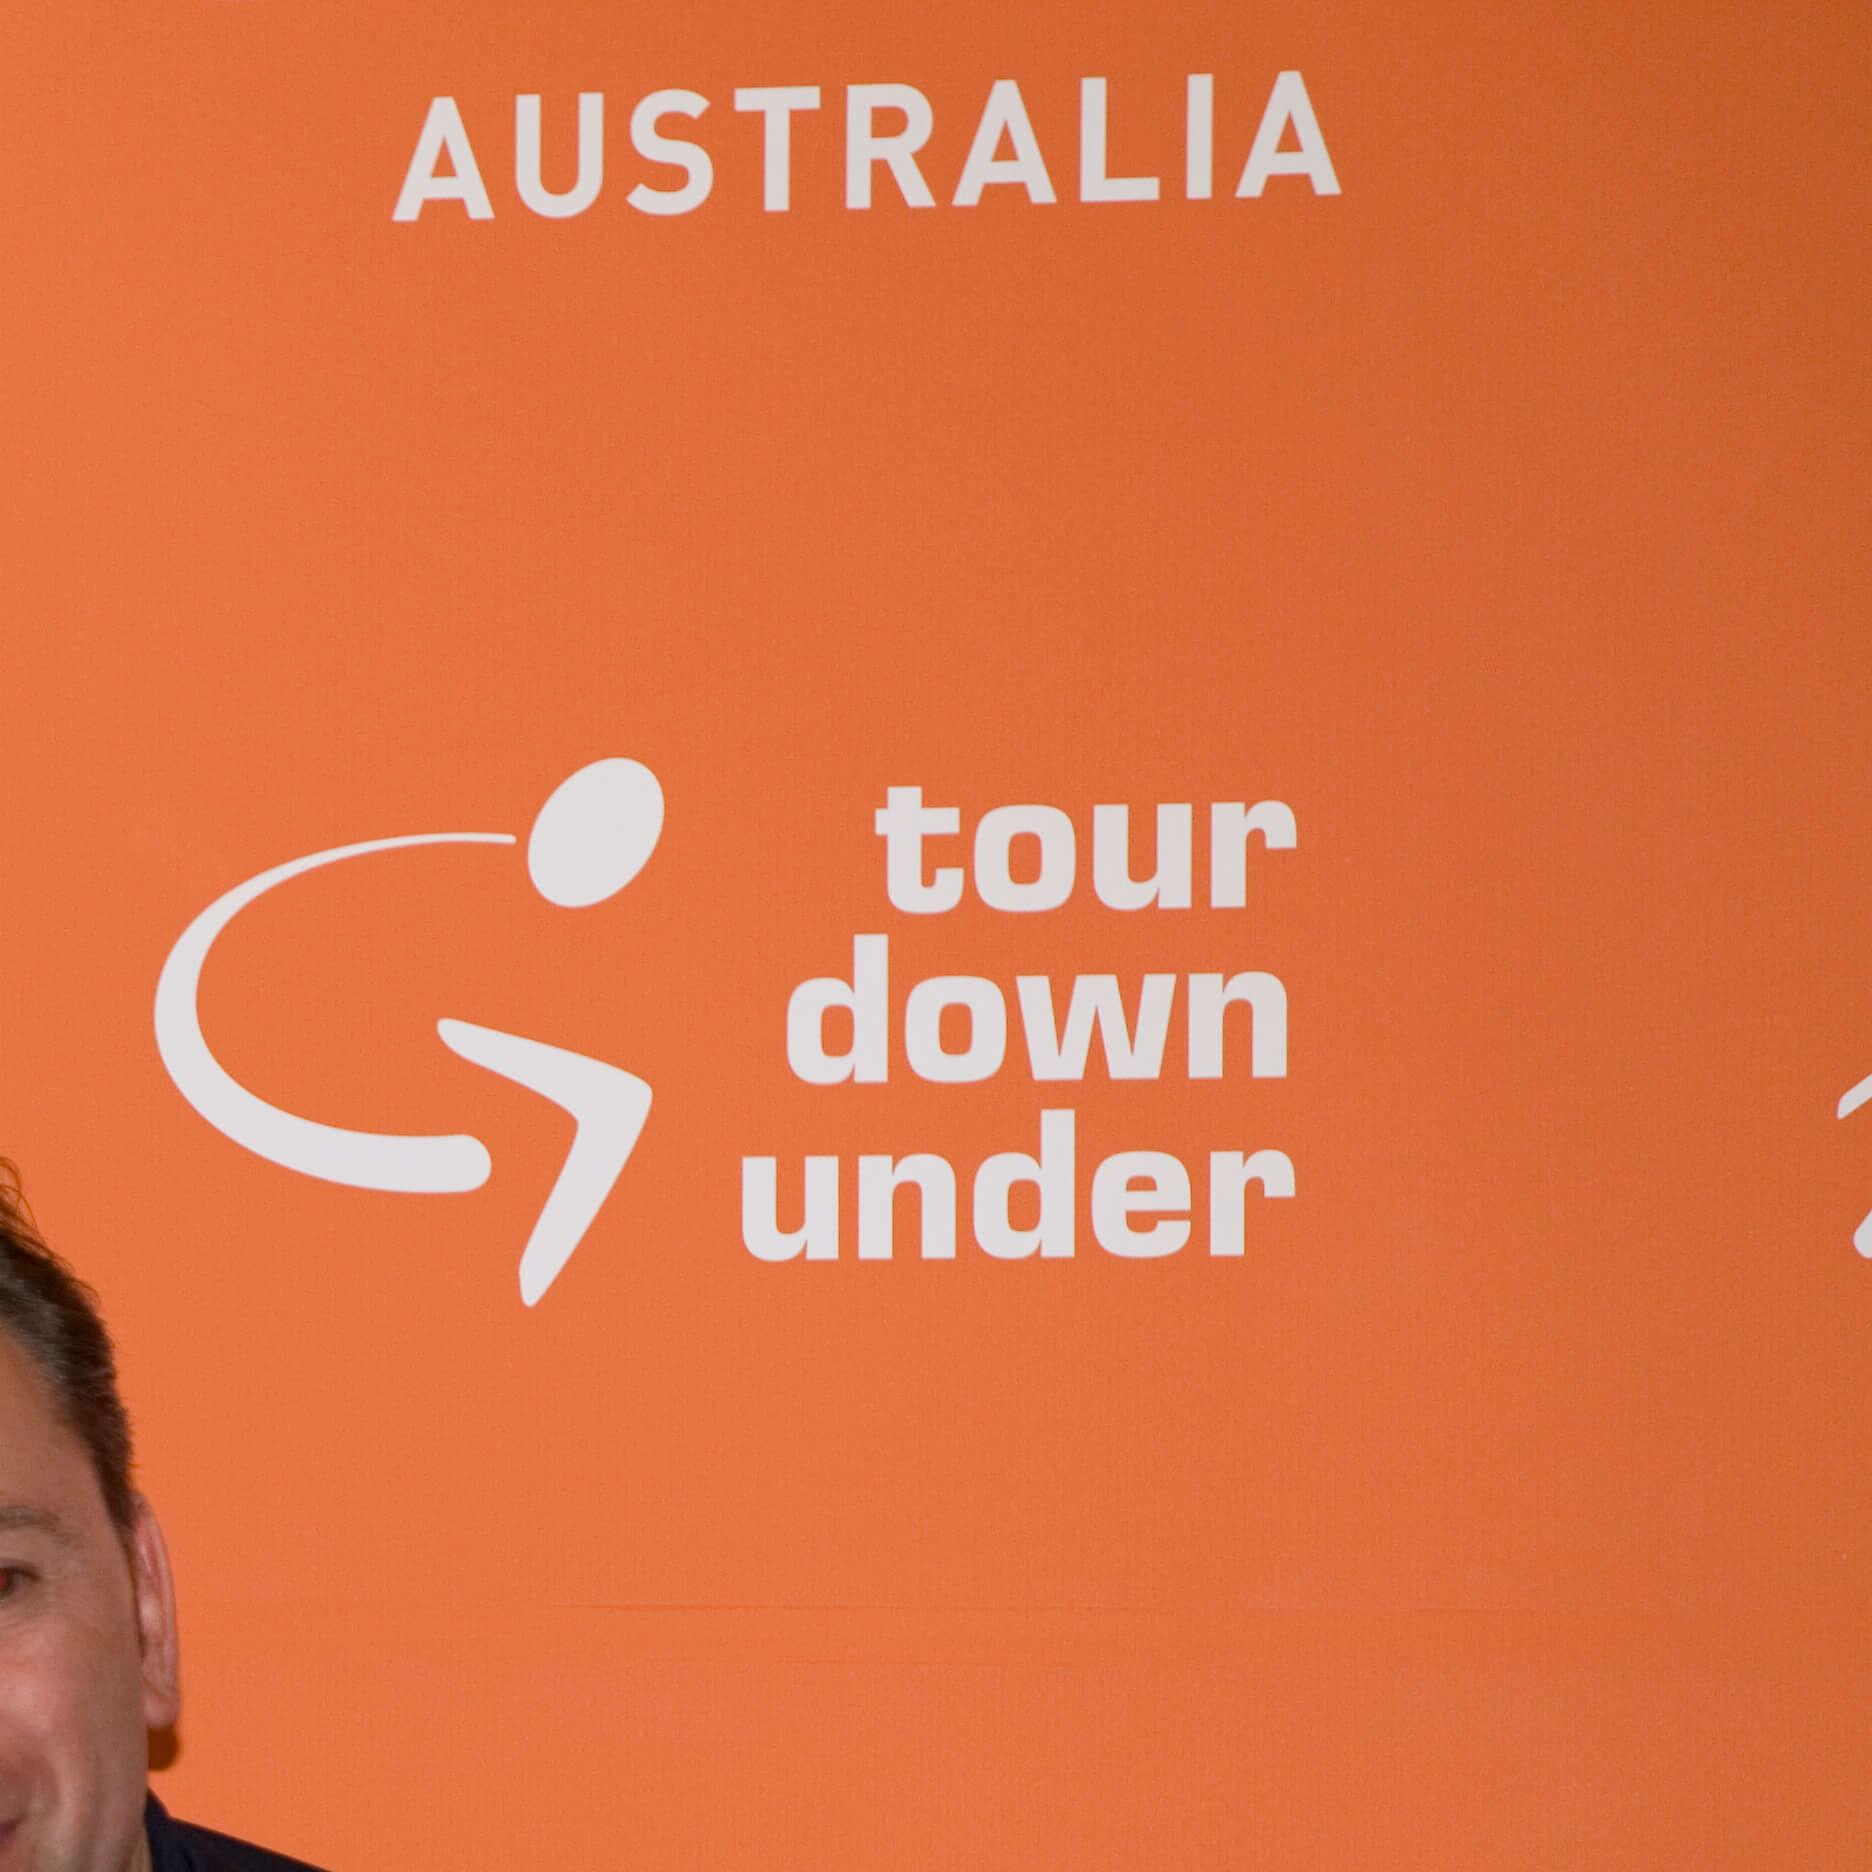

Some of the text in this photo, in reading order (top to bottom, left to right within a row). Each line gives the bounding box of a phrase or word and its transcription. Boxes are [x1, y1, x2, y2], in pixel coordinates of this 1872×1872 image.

[392, 71, 1342, 222] AUSTRALIA
[874, 785, 1298, 915] tour
[785, 933, 1289, 1085] down
[741, 1107, 1297, 1262] under
